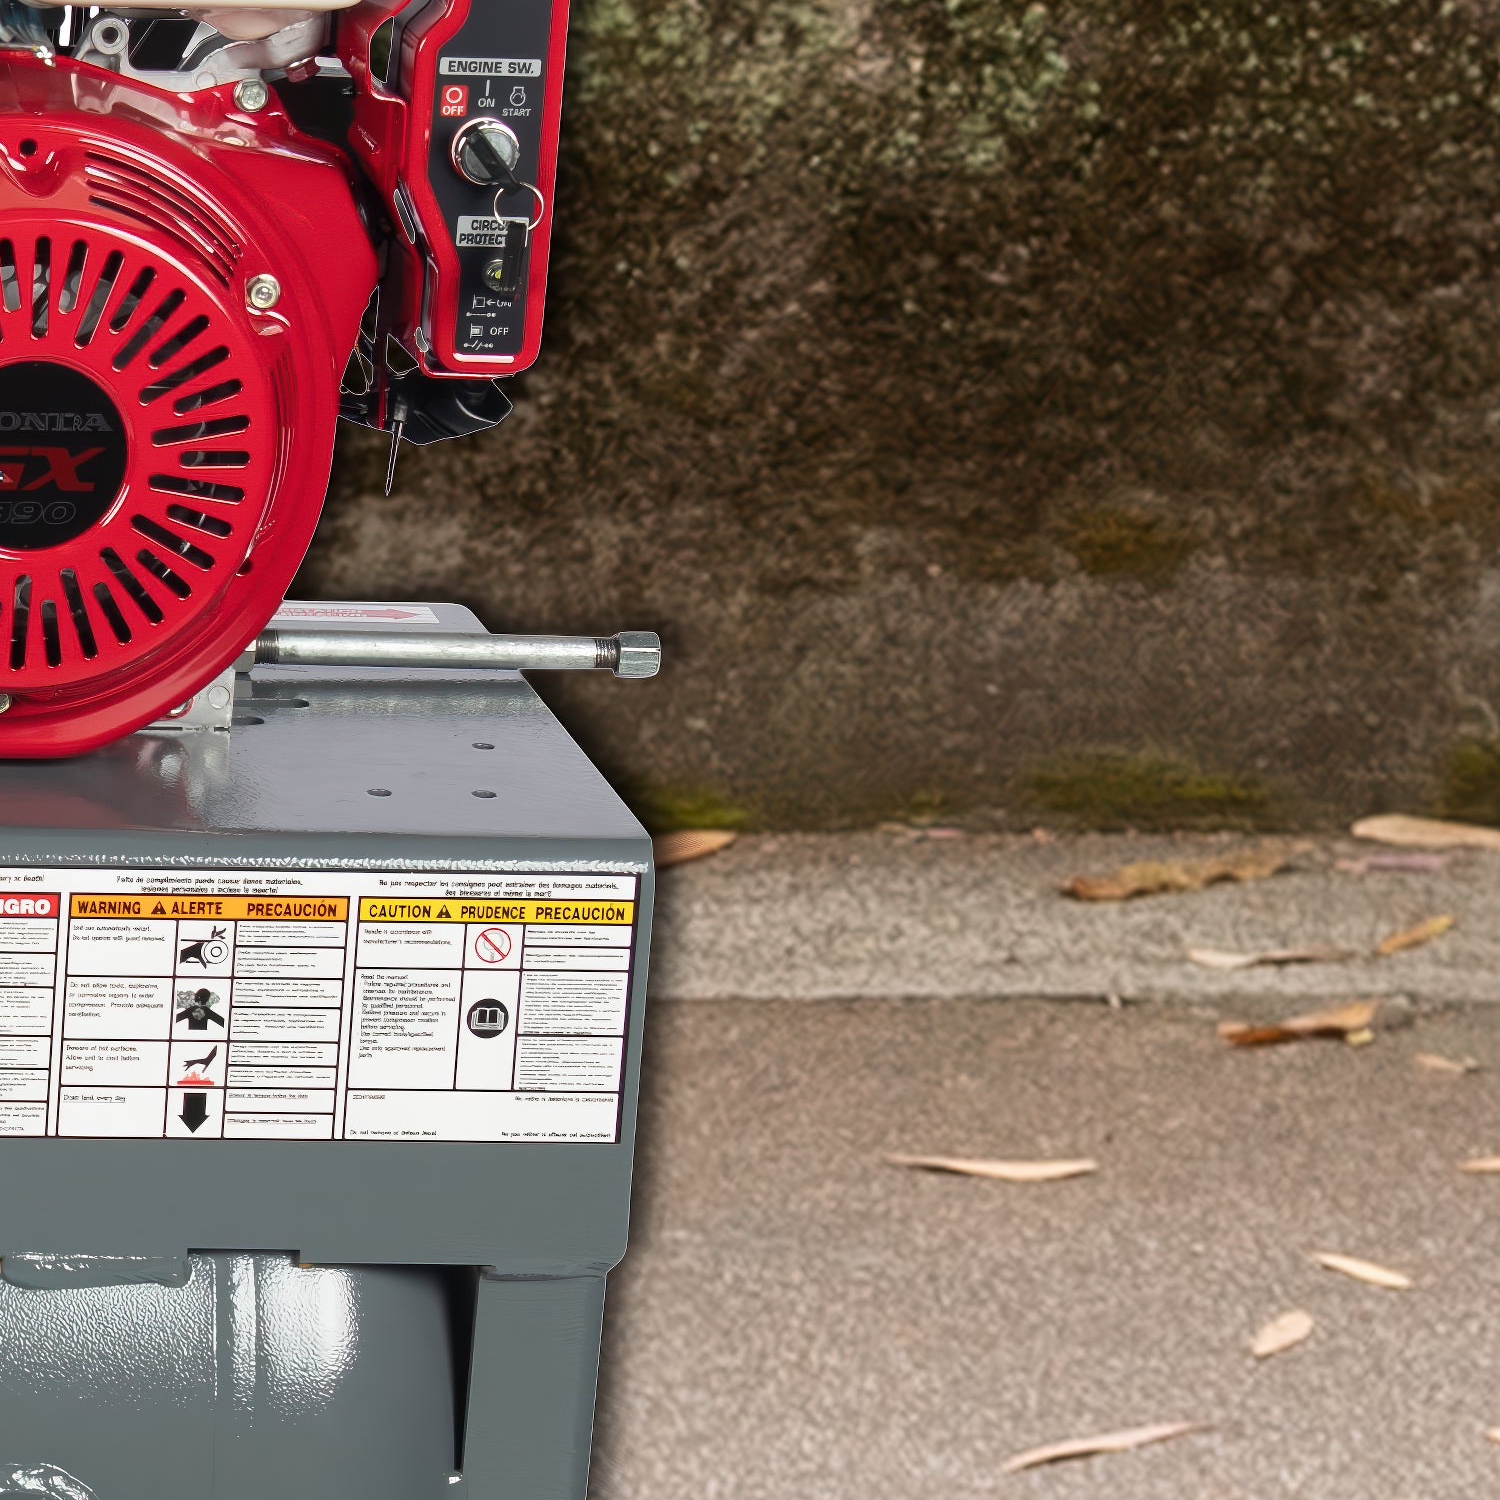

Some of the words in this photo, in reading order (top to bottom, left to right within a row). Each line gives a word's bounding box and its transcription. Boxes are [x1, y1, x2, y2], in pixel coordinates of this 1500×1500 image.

[448, 61, 502, 73] ENGINE
[508, 62, 534, 73] SW.
[478, 99, 495, 107] ON
[443, 106, 463, 115] OFF
[471, 220, 505, 231] CIRCU
[459, 234, 506, 244] PROTEC
[78, 901, 140, 914] WARNING
[172, 902, 222, 914] ALERTE
[247, 900, 336, 917] PRECAUCIÓN
[370, 905, 431, 918] CAUTION
[461, 907, 526, 919] PRUDENCE
[536, 904, 625, 920] PRECAUCIÓN
